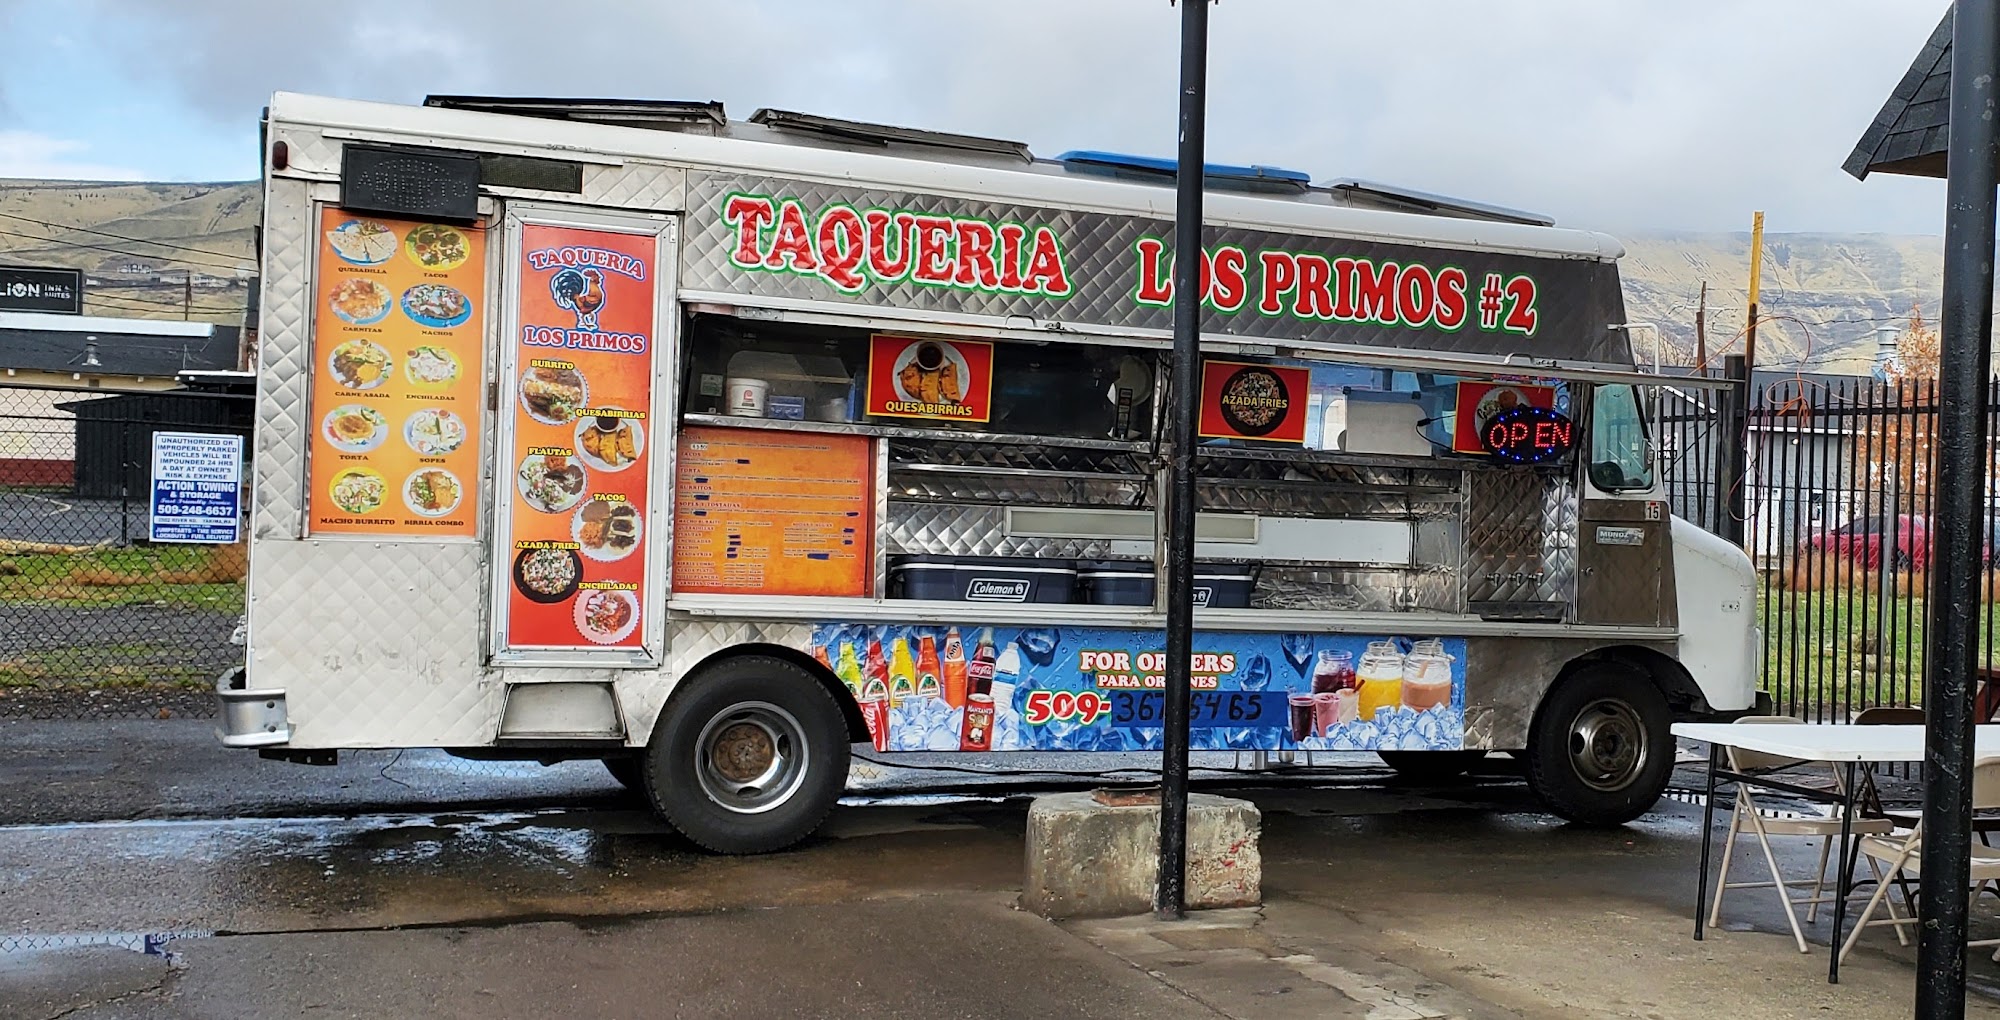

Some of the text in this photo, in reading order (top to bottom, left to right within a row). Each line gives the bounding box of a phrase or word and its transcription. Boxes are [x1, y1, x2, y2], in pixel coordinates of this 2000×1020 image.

[357, 171, 468, 197] ABIERTO
[530, 248, 645, 279] TAQUERIA
[724, 194, 1071, 293] TAQUERIA
[1259, 249, 1467, 331] PRIMOS
[1480, 273, 1538, 337] #2
[338, 266, 387, 275] QUESADILLA
[342, 326, 382, 334] CARNITAS
[421, 329, 453, 337] NACHOS
[525, 327, 645, 351] LOS PRIMOS
[531, 359, 574, 370] BURRITO
[1222, 394, 1288, 409] AZADA FRIES
[575, 408, 645, 419] QUESABIRRIAS
[885, 401, 973, 416] QUESABIRRIAS
[1489, 422, 1571, 448] OPEN
[161, 437, 221, 446] UNAUTHORIZED
[528, 447, 573, 456] FLAUTAS
[157, 481, 236, 492] ACTION TOWING
[179, 491, 222, 499] STORAGE
[593, 493, 626, 502] TACOS
[157, 504, 233, 516] 509-248-6637
[1647, 506, 1659, 519] 15
[320, 517, 353, 525] MACHO
[516, 541, 580, 550] AZADA FRIES
[578, 582, 638, 591] ENCHILADAS
[973, 581, 1014, 595] Coleman
[1080, 652, 1235, 673] FOR ORERS
[1097, 674, 1218, 688] PARA ORNES
